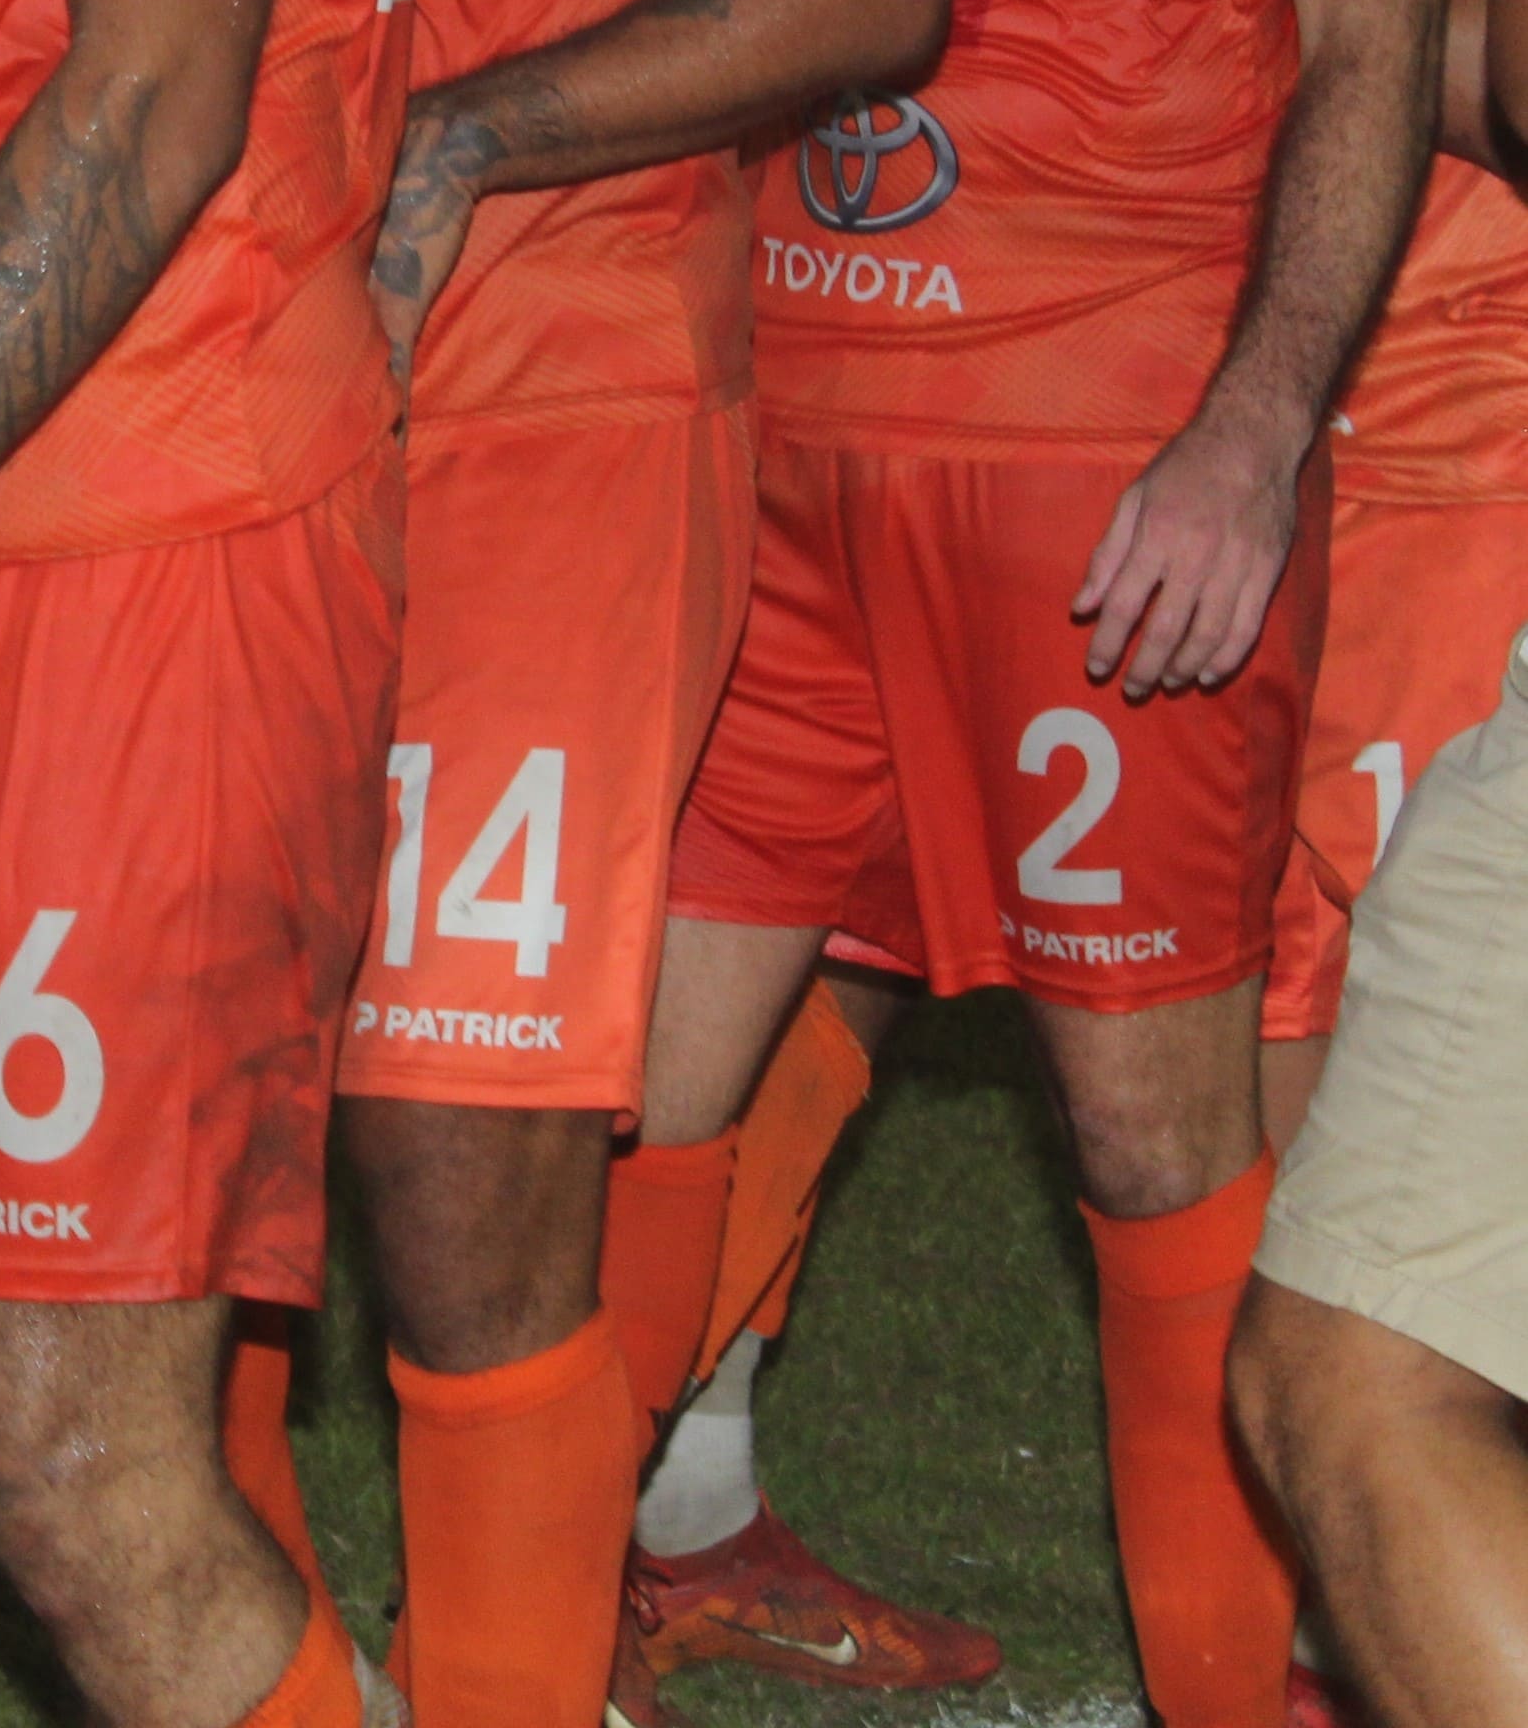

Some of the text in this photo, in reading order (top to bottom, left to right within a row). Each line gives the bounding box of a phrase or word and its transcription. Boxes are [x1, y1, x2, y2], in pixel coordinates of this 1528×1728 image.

[762, 236, 963, 313] TOYOTA
[1017, 707, 1123, 905] 2
[386, 742, 567, 978] 14
[1022, 926, 1180, 965] PATRICK
[383, 1004, 564, 1051] PATRICK
